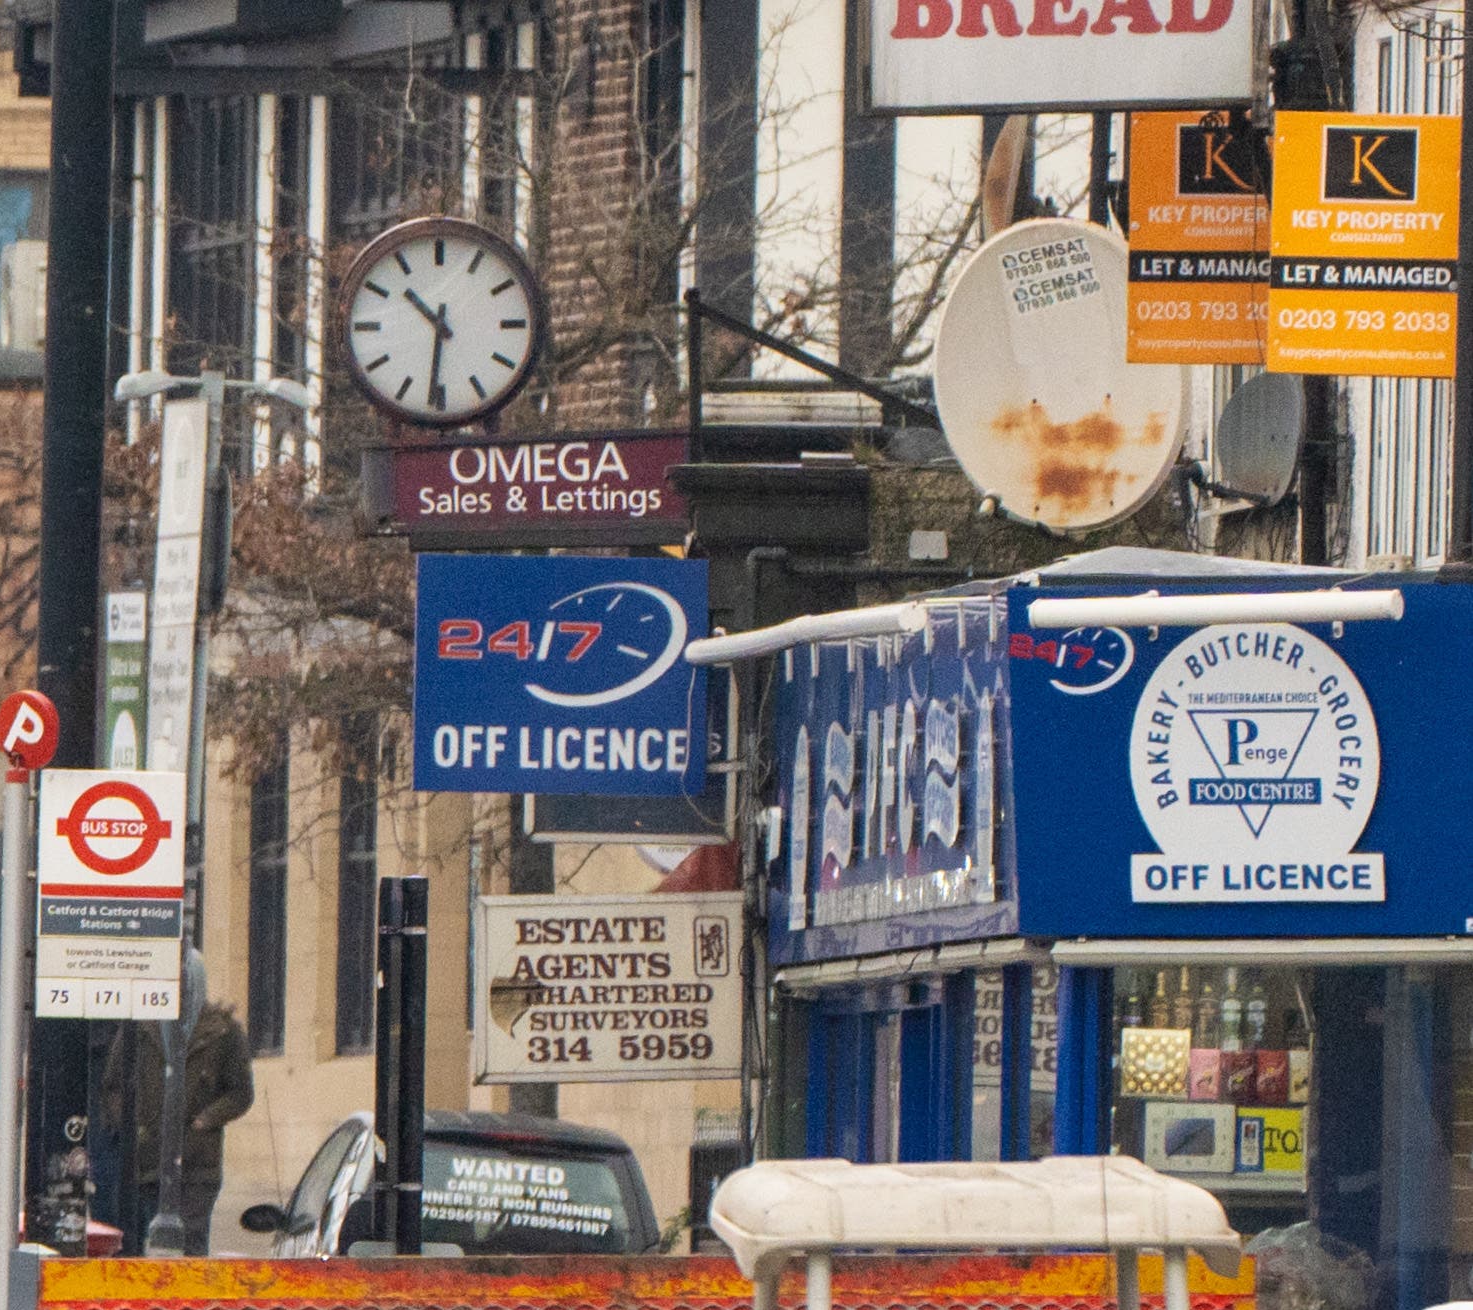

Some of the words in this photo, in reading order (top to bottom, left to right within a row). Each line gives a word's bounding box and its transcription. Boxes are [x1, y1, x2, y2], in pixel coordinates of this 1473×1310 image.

[889, 0, 1234, 39] BREAD
[1203, 132, 1257, 191] K
[1351, 136, 1407, 197] K
[1148, 206, 1184, 223] KEY
[1189, 206, 1271, 223] PROPER
[1291, 209, 1332, 227] KEY
[1336, 210, 1443, 231] PROPERTY
[1329, 231, 1405, 244] CONSULTANTS
[1017, 238, 1085, 265] CEMSAT
[1140, 259, 1175, 276] LET
[1179, 259, 1197, 276] &
[1283, 264, 1319, 283] LET
[1324, 264, 1341, 283] &
[1343, 266, 1452, 286] MANAGED
[1029, 268, 1094, 297] CEMSAT
[1136, 301, 1192, 321] 0203
[1199, 301, 1239, 321] 793
[1245, 302, 1271, 321] 20
[1278, 309, 1336, 330] 0203
[1344, 310, 1385, 331] 793
[1393, 311, 1450, 332] 2033
[449, 442, 629, 484] OMEGA
[418, 486, 492, 514] Sales
[506, 486, 527, 512] &
[541, 485, 661, 516] Lettings
[438, 619, 602, 662] 24/7
[1188, 693, 1204, 705] THE
[1206, 693, 1283, 705] MEDITERRANEAN
[2, 701, 45, 752] P
[1147, 690, 1180, 809] BAKERY
[1185, 631, 1305, 679] BUTCHER
[1318, 674, 1363, 810] GROCERY
[433, 725, 508, 768] OFF
[519, 727, 690, 773] LICENCE
[1224, 717, 1288, 767] Penge
[1195, 783, 1246, 800] FOOD
[1249, 783, 1315, 800] CENTRE
[81, 820, 109, 835] BUS
[111, 821, 148, 836] STOP
[1144, 863, 1209, 891] OFF
[1222, 863, 1372, 891] LICENCE
[47, 904, 87, 917] Catford
[88, 906, 98, 918] &
[99, 905, 139, 919] Catford
[141, 907, 174, 922] Bridge
[79, 918, 122, 931] Stations
[515, 916, 667, 946] ESTATE
[65, 947, 104, 958] towards
[106, 947, 153, 959] Lewisham
[78, 960, 117, 971] Catford
[118, 961, 150, 973] Garage
[512, 952, 672, 981] AGENTS
[50, 990, 70, 1005] 75
[95, 990, 121, 1006] 171
[141, 992, 170, 1007] 185
[528, 984, 714, 1006] HARTERED
[529, 1008, 709, 1031] SURVEYORS
[527, 1036, 593, 1063] 314
[619, 1034, 714, 1061] 5959
[452, 1157, 566, 1186] WANTED
[447, 1178, 488, 1193] CARS
[492, 1181, 524, 1196] AND
[528, 1185, 569, 1201] VANS
[502, 1197, 537, 1212] NON
[541, 1200, 613, 1220] RUNNERS
